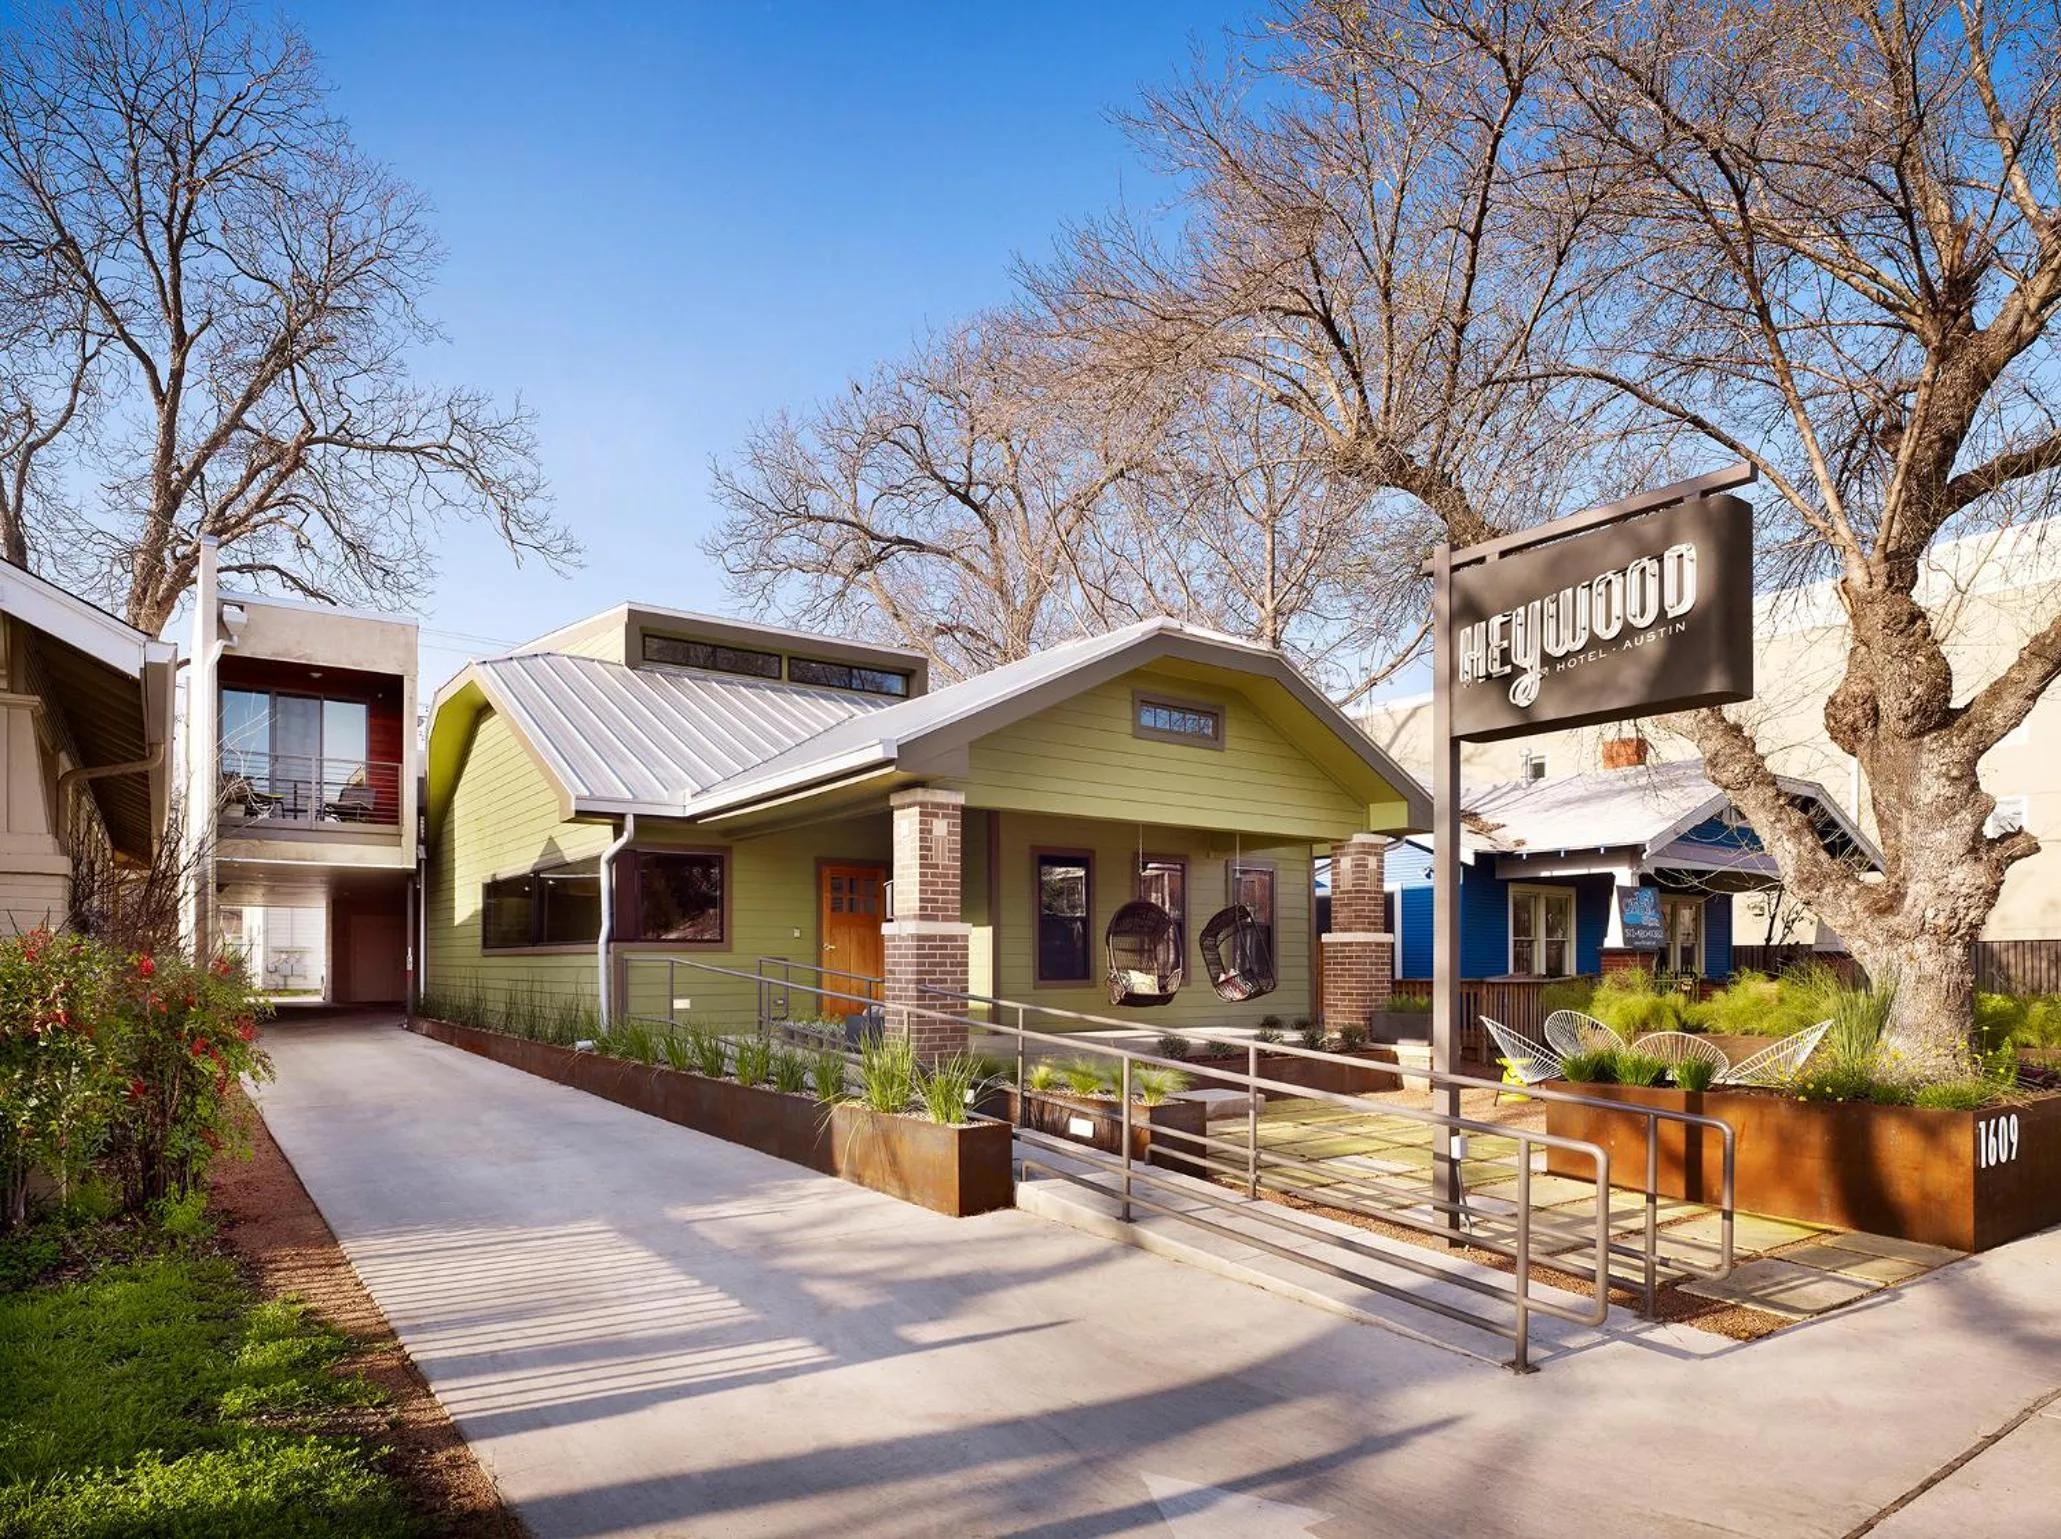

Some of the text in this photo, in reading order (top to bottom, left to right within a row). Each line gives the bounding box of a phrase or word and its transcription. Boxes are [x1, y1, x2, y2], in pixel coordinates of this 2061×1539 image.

[1556, 621, 1687, 673] HOTEL AUSTIN
[1978, 1113, 2019, 1169] 1609
